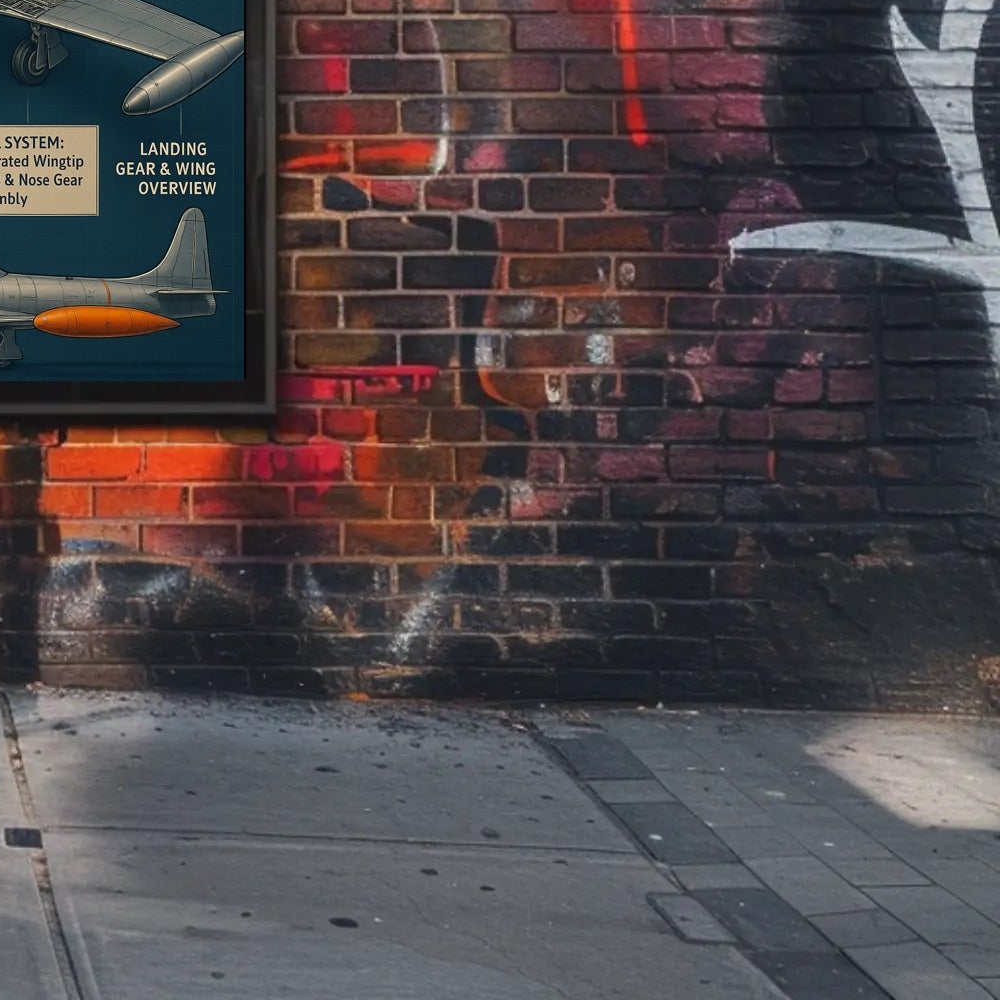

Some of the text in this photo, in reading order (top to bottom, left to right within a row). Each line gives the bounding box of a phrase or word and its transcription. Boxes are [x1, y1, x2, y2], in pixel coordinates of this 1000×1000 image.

[4, 135, 64, 150] SYSTEM:
[140, 141, 207, 156] LANDING
[33, 154, 84, 171] Wingtip
[115, 161, 216, 176] GEAR & WING
[4, 172, 15, 187] &
[18, 172, 50, 187] Nose
[53, 173, 84, 187] Gear
[138, 181, 217, 195] OVERVIEW
